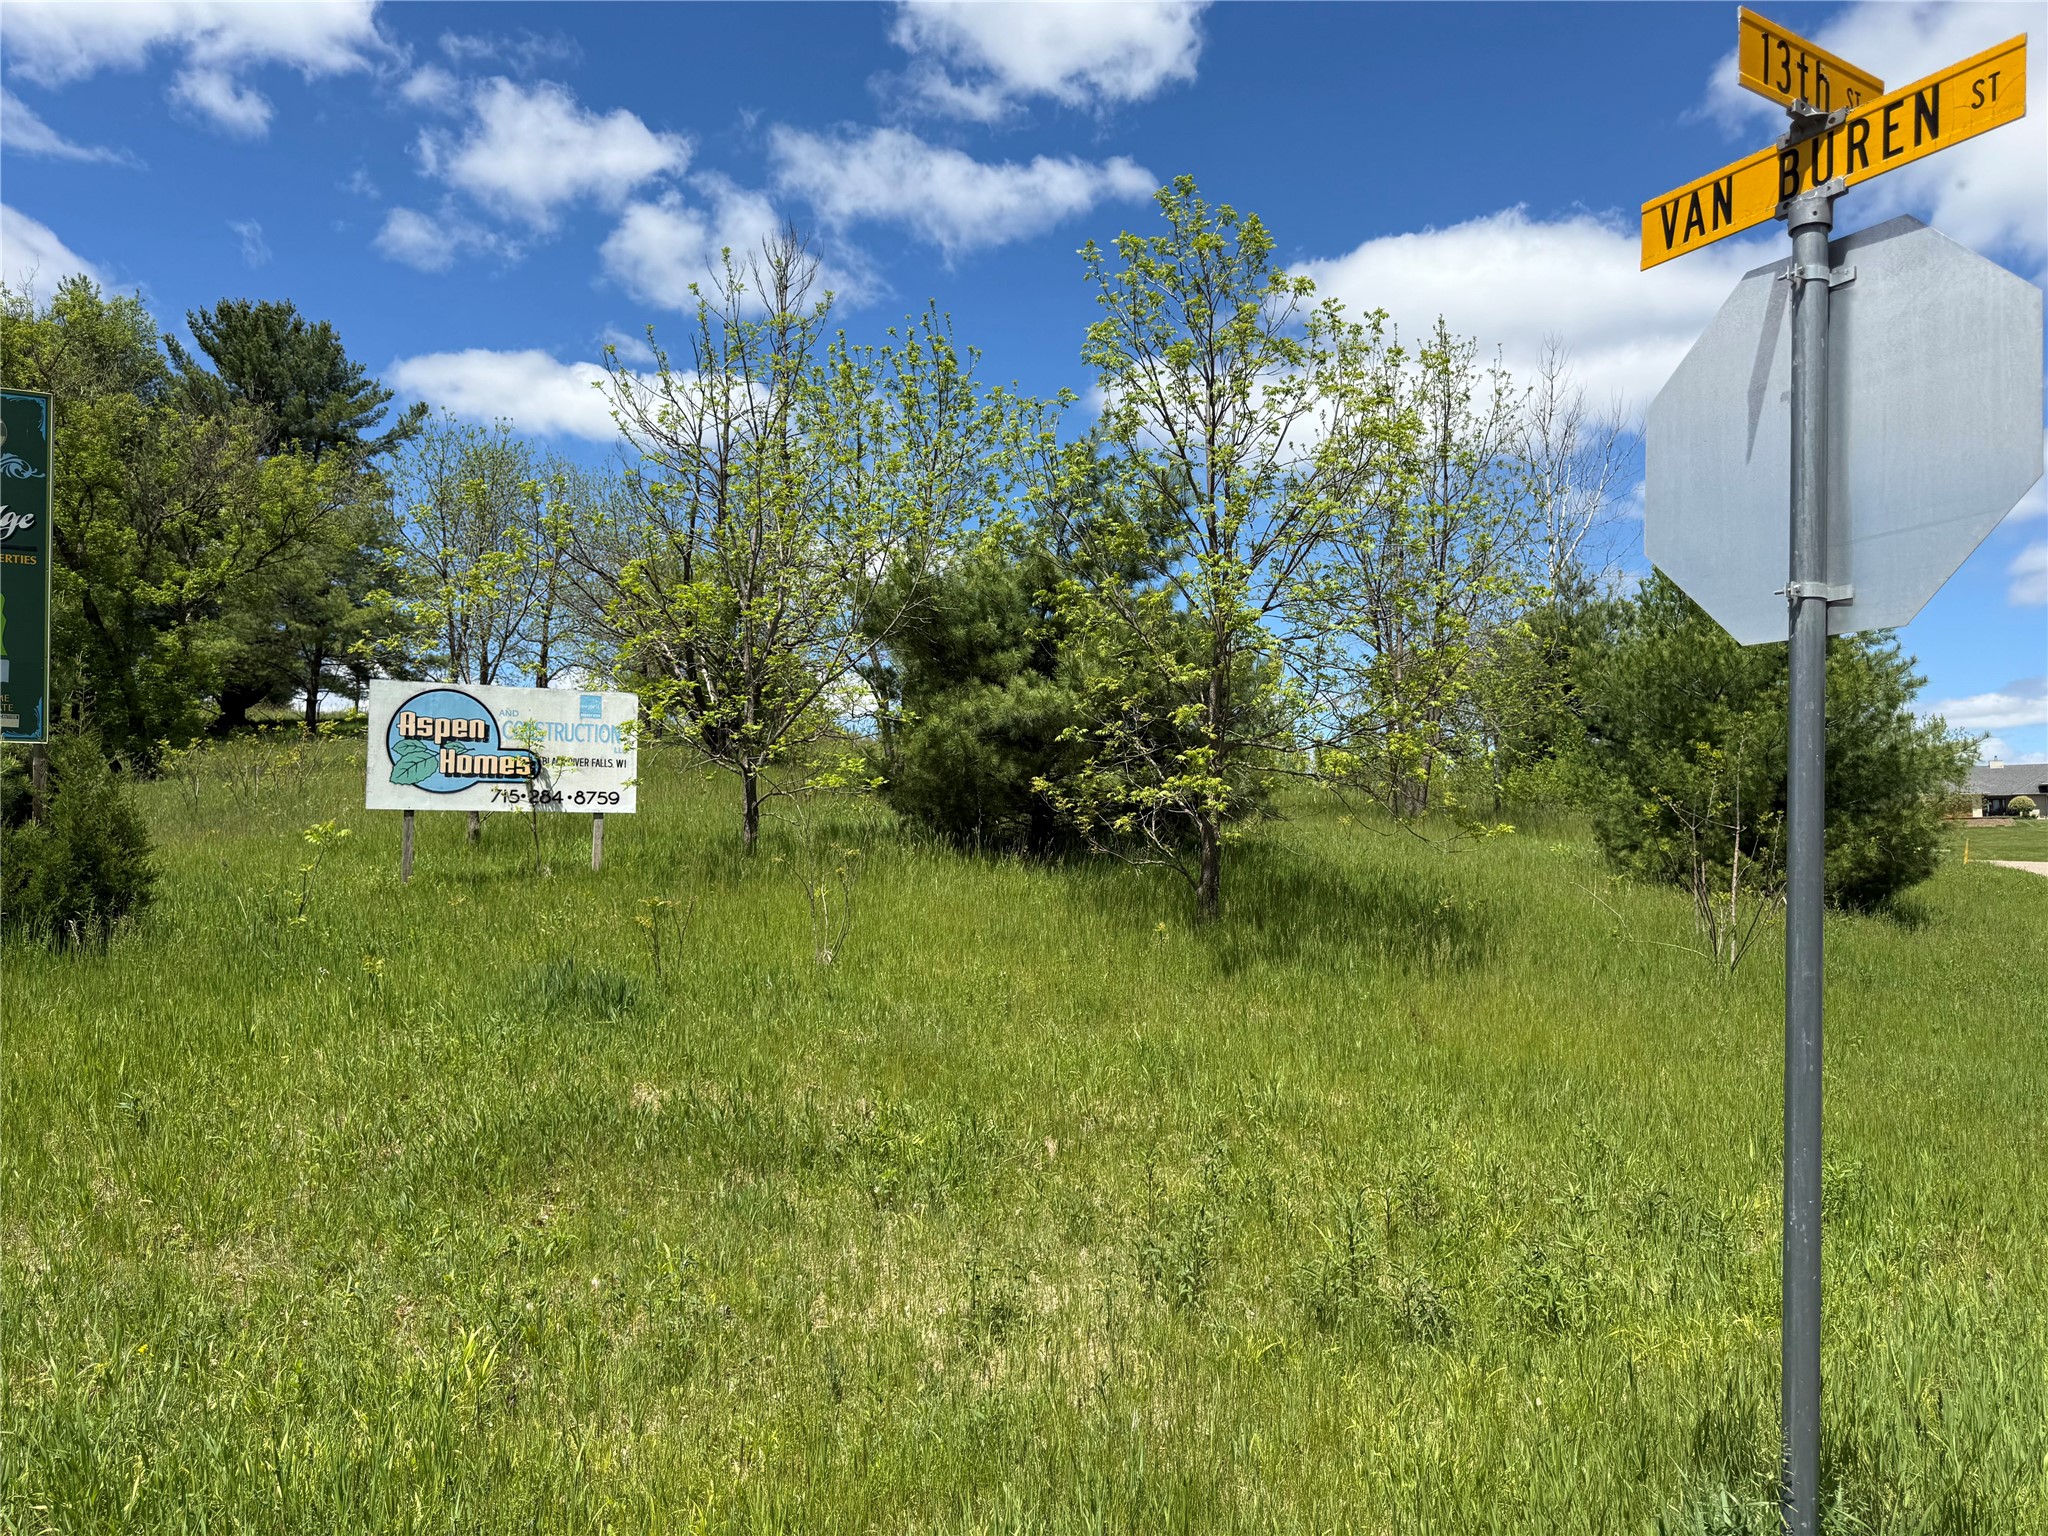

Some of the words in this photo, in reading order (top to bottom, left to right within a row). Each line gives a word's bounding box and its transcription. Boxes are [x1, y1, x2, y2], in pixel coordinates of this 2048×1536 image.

[1761, 32, 1830, 113] 13th
[1846, 87, 1862, 110] ST
[1659, 175, 1733, 250] VAN
[1779, 84, 1941, 201] BUREN
[1971, 71, 2001, 110] ST
[396, 710, 488, 745] Aspen
[498, 709, 520, 718] AND
[502, 720, 621, 745] COSTRUCTION
[439, 747, 532, 776] Homes
[616, 759, 627, 769] WI
